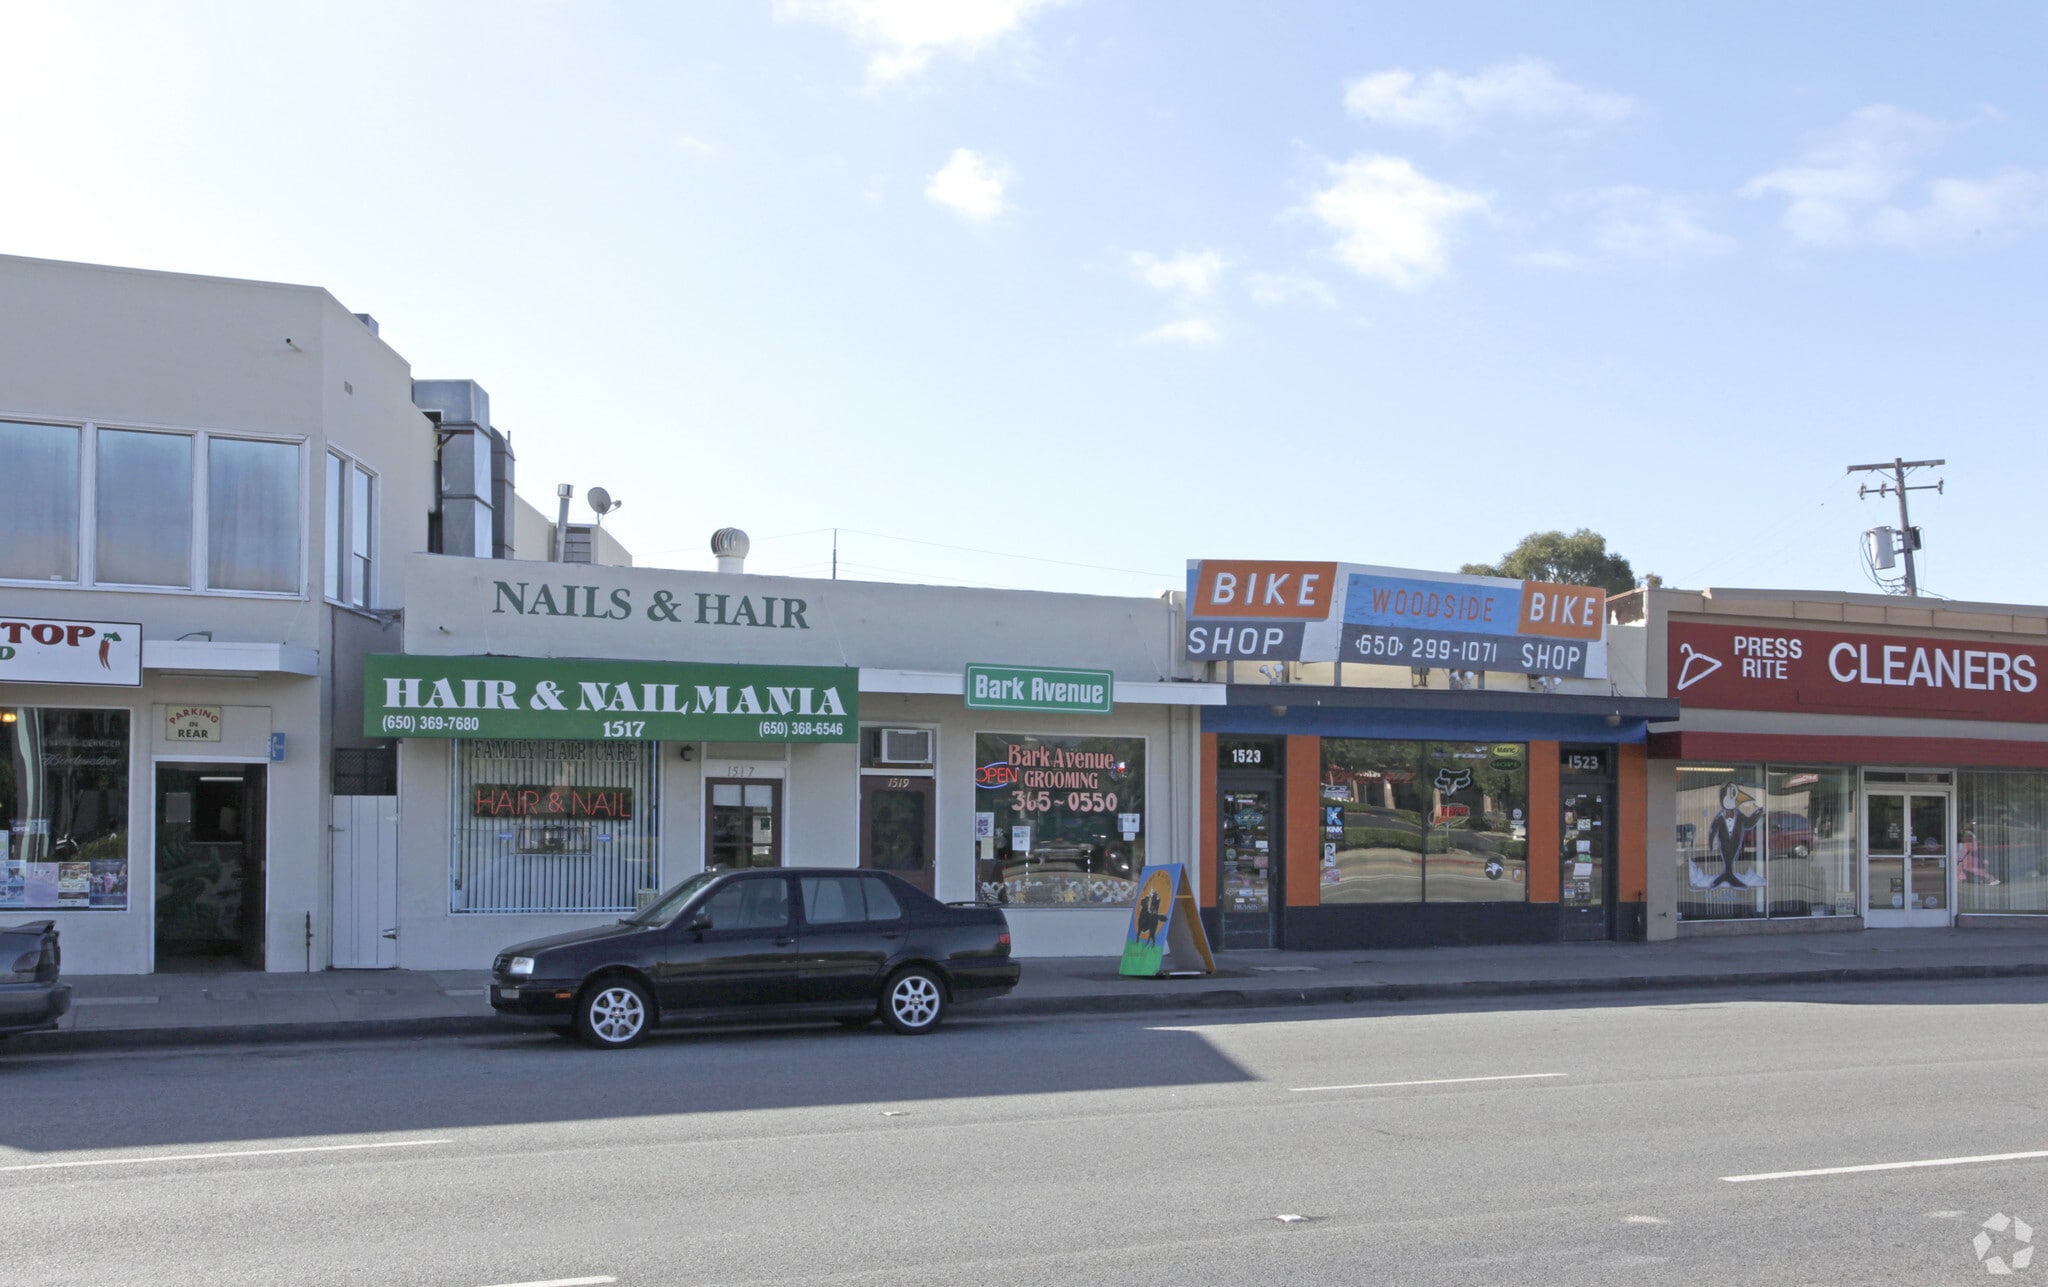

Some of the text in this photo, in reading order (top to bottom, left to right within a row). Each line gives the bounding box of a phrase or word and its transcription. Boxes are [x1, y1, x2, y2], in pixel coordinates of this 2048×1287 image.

[1209, 572, 1319, 607] BIKE
[492, 580, 811, 630] NAILS & HAIR
[1372, 587, 1496, 623] WOODSIDE
[1528, 591, 1597, 628] BIKE
[1187, 626, 1284, 656] SHOP
[1411, 638, 1498, 663] 299-1071
[1734, 635, 1803, 660] PRESS
[1521, 642, 1581, 671] SHOP
[1828, 641, 2038, 693] CLEANERS
[1742, 660, 1789, 680] RITE
[382, 677, 521, 710] HAIR
[530, 679, 569, 712] &
[975, 674, 1104, 704] Bark Avenue
[169, 707, 219, 725] PARKING
[382, 715, 480, 733] (650) 369-7680
[178, 729, 209, 739] REAR
[603, 720, 646, 738] 1517
[759, 721, 844, 738] (650) 368-6546
[473, 740, 639, 763] FAMILY HAIR CARE
[1008, 744, 1115, 770] Bark Avenue
[1231, 749, 1262, 764] 1523
[1568, 755, 1599, 770] 1523
[727, 766, 755, 777] 1517
[887, 777, 910, 789] 1519
[975, 767, 1019, 784] OPEN
[1024, 770, 1099, 789] GROOMING
[476, 789, 632, 818] HAIR & NAIL
